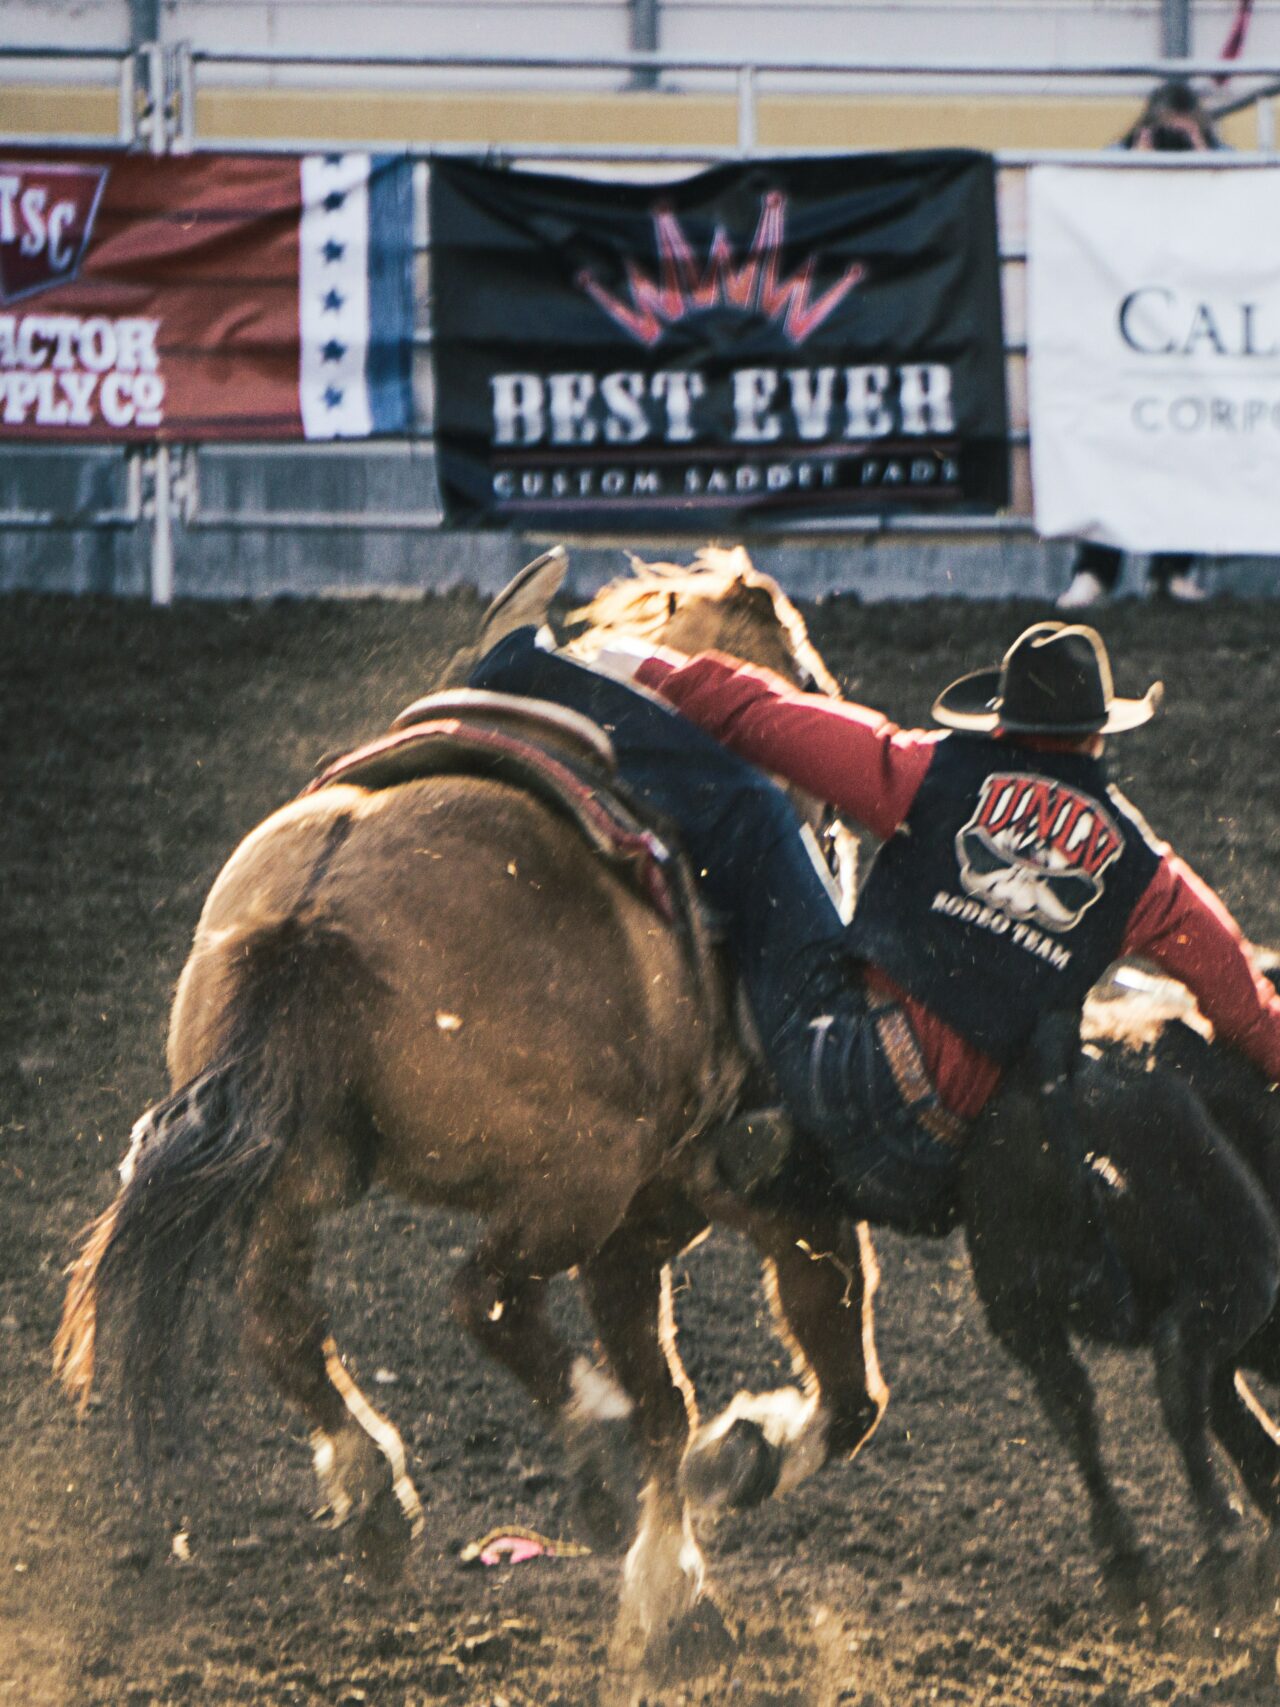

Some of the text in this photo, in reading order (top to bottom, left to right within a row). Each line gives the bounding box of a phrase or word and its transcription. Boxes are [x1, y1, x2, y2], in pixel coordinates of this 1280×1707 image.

[1117, 286, 1279, 358] CAL
[0, 371, 98, 427] PLY
[490, 363, 956, 446] BEST EVER
[492, 468, 660, 498] CUSTOM
[977, 777, 1121, 878] UNLV
[930, 890, 1073, 972] RODEO TEAM
